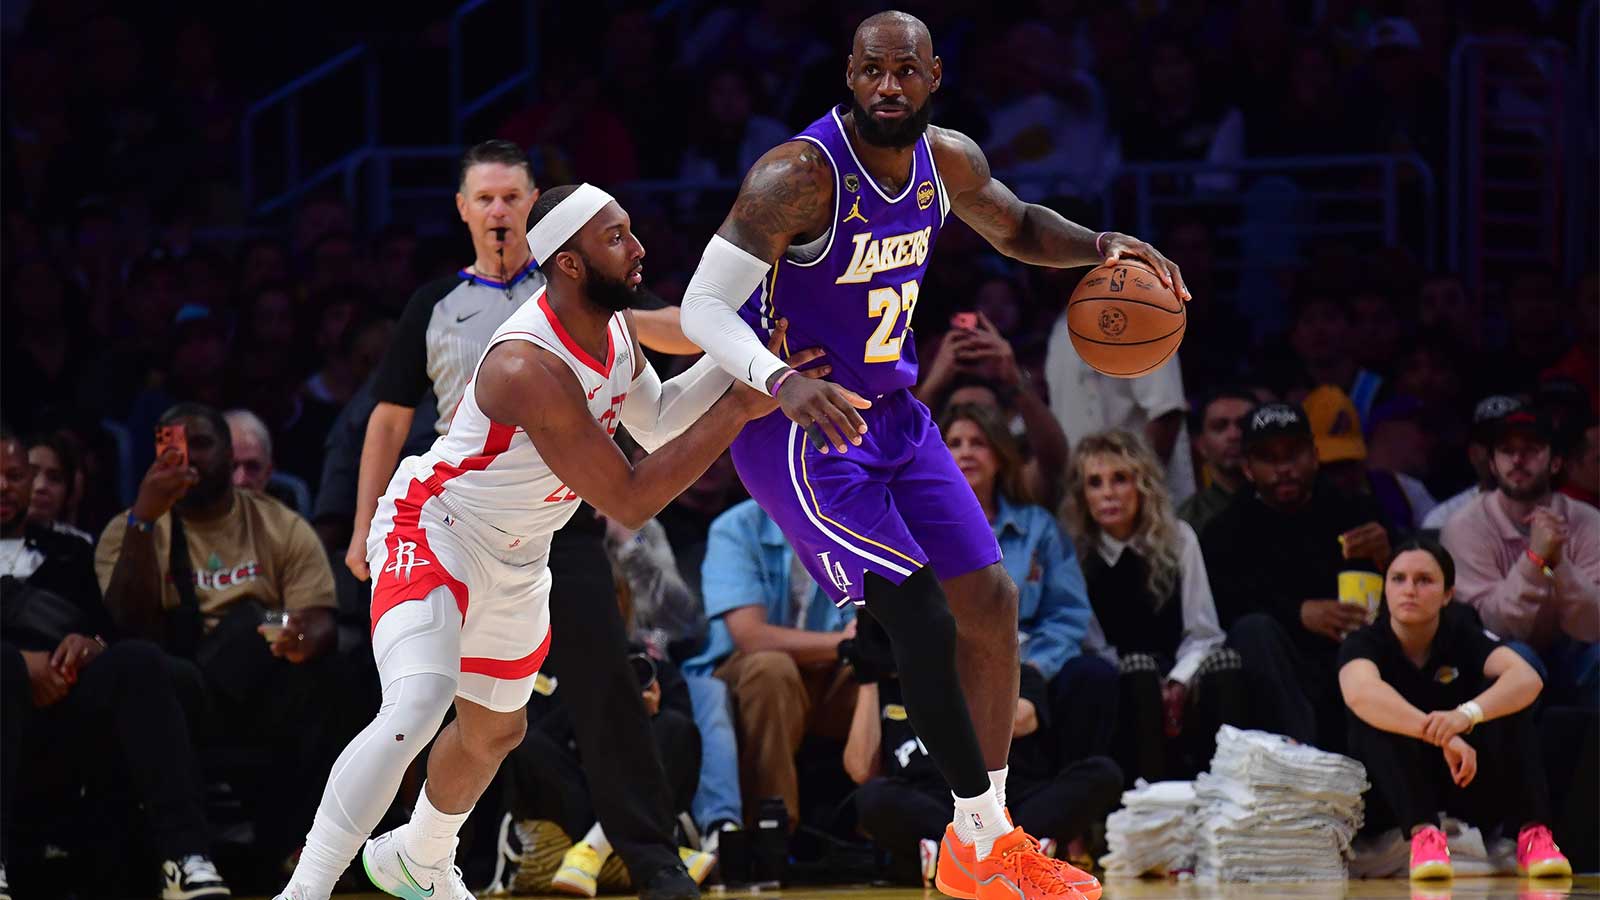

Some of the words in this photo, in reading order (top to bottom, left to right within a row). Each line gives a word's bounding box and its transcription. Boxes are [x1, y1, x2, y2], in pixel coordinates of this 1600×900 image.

[835, 226, 932, 284] LAKERS
[196, 559, 258, 592] UCCI
[817, 551, 853, 593] LA
